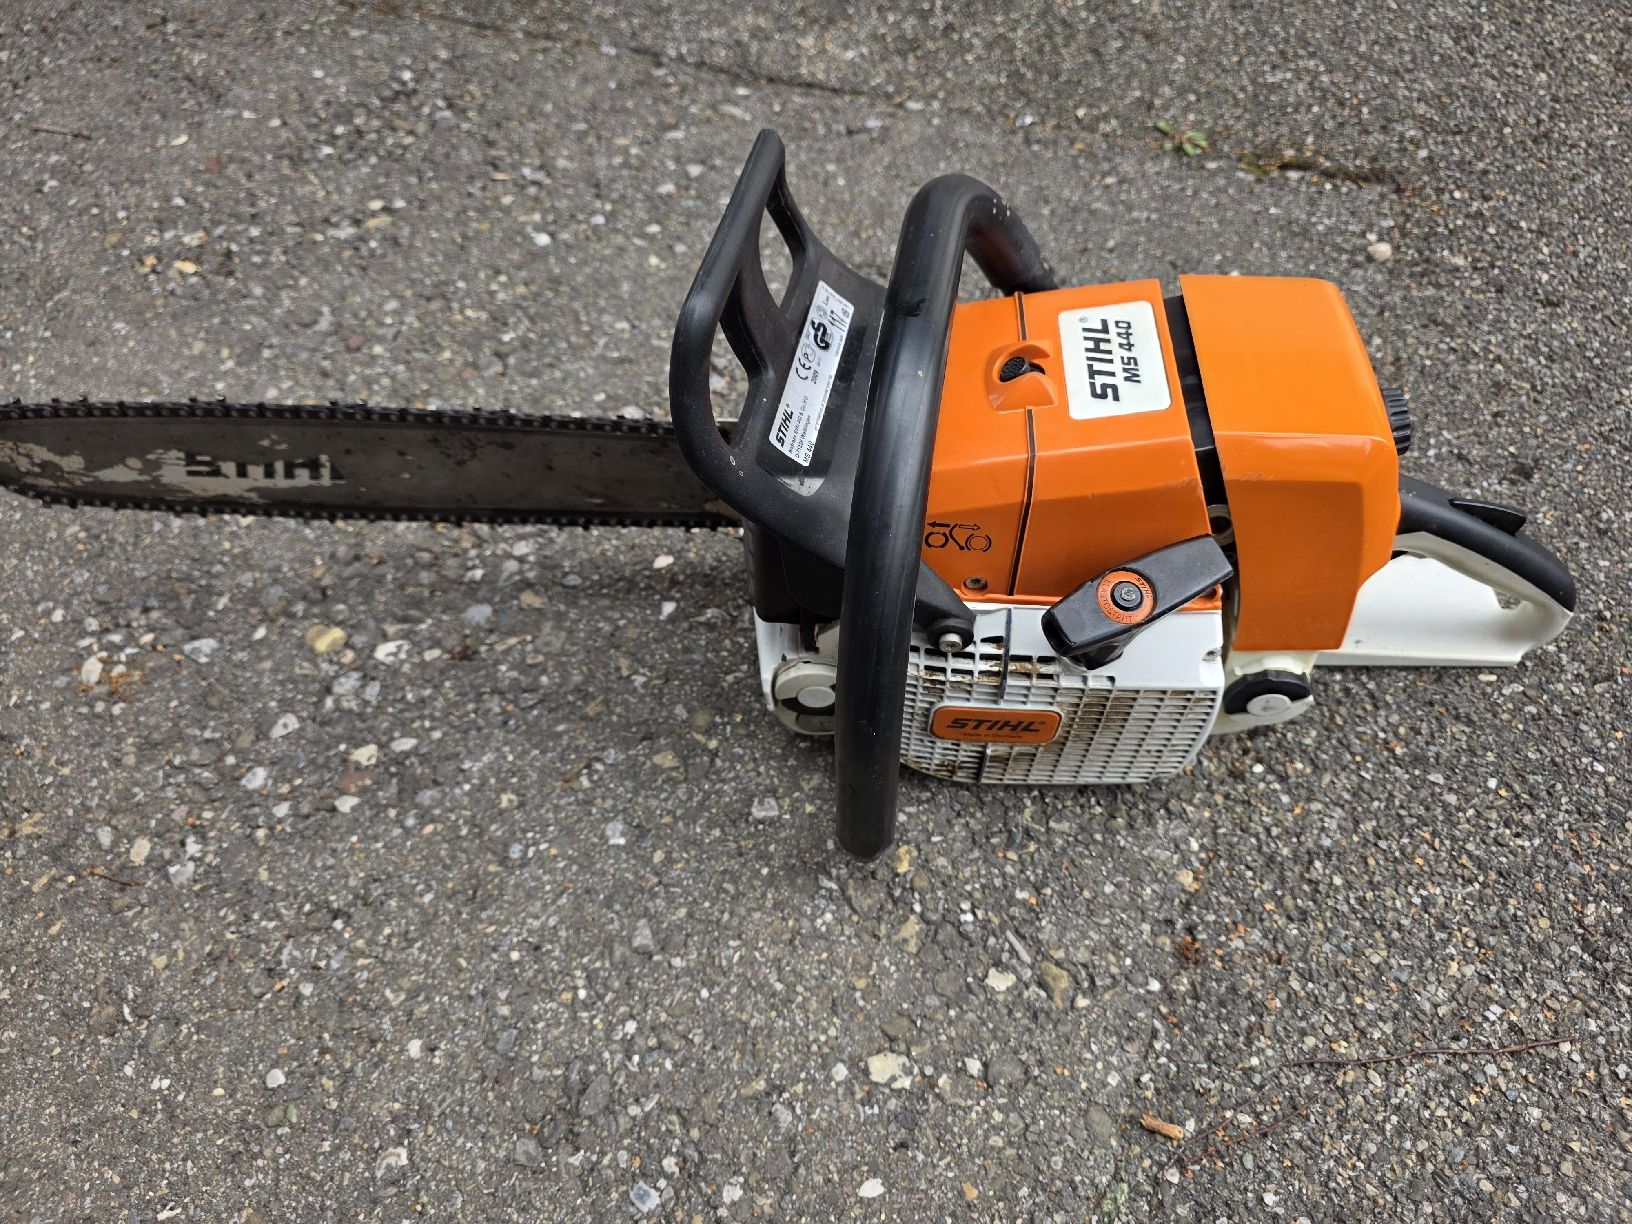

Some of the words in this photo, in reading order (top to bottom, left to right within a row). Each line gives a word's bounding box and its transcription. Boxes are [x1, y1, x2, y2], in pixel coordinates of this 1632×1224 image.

[1114, 320, 1135, 352] 440
[1082, 318, 1120, 402] STIHL
[1120, 356, 1142, 384] MS
[776, 409, 794, 448] STIHL
[1135, 577, 1153, 599] STIHL
[946, 718, 1041, 733] STIHL
